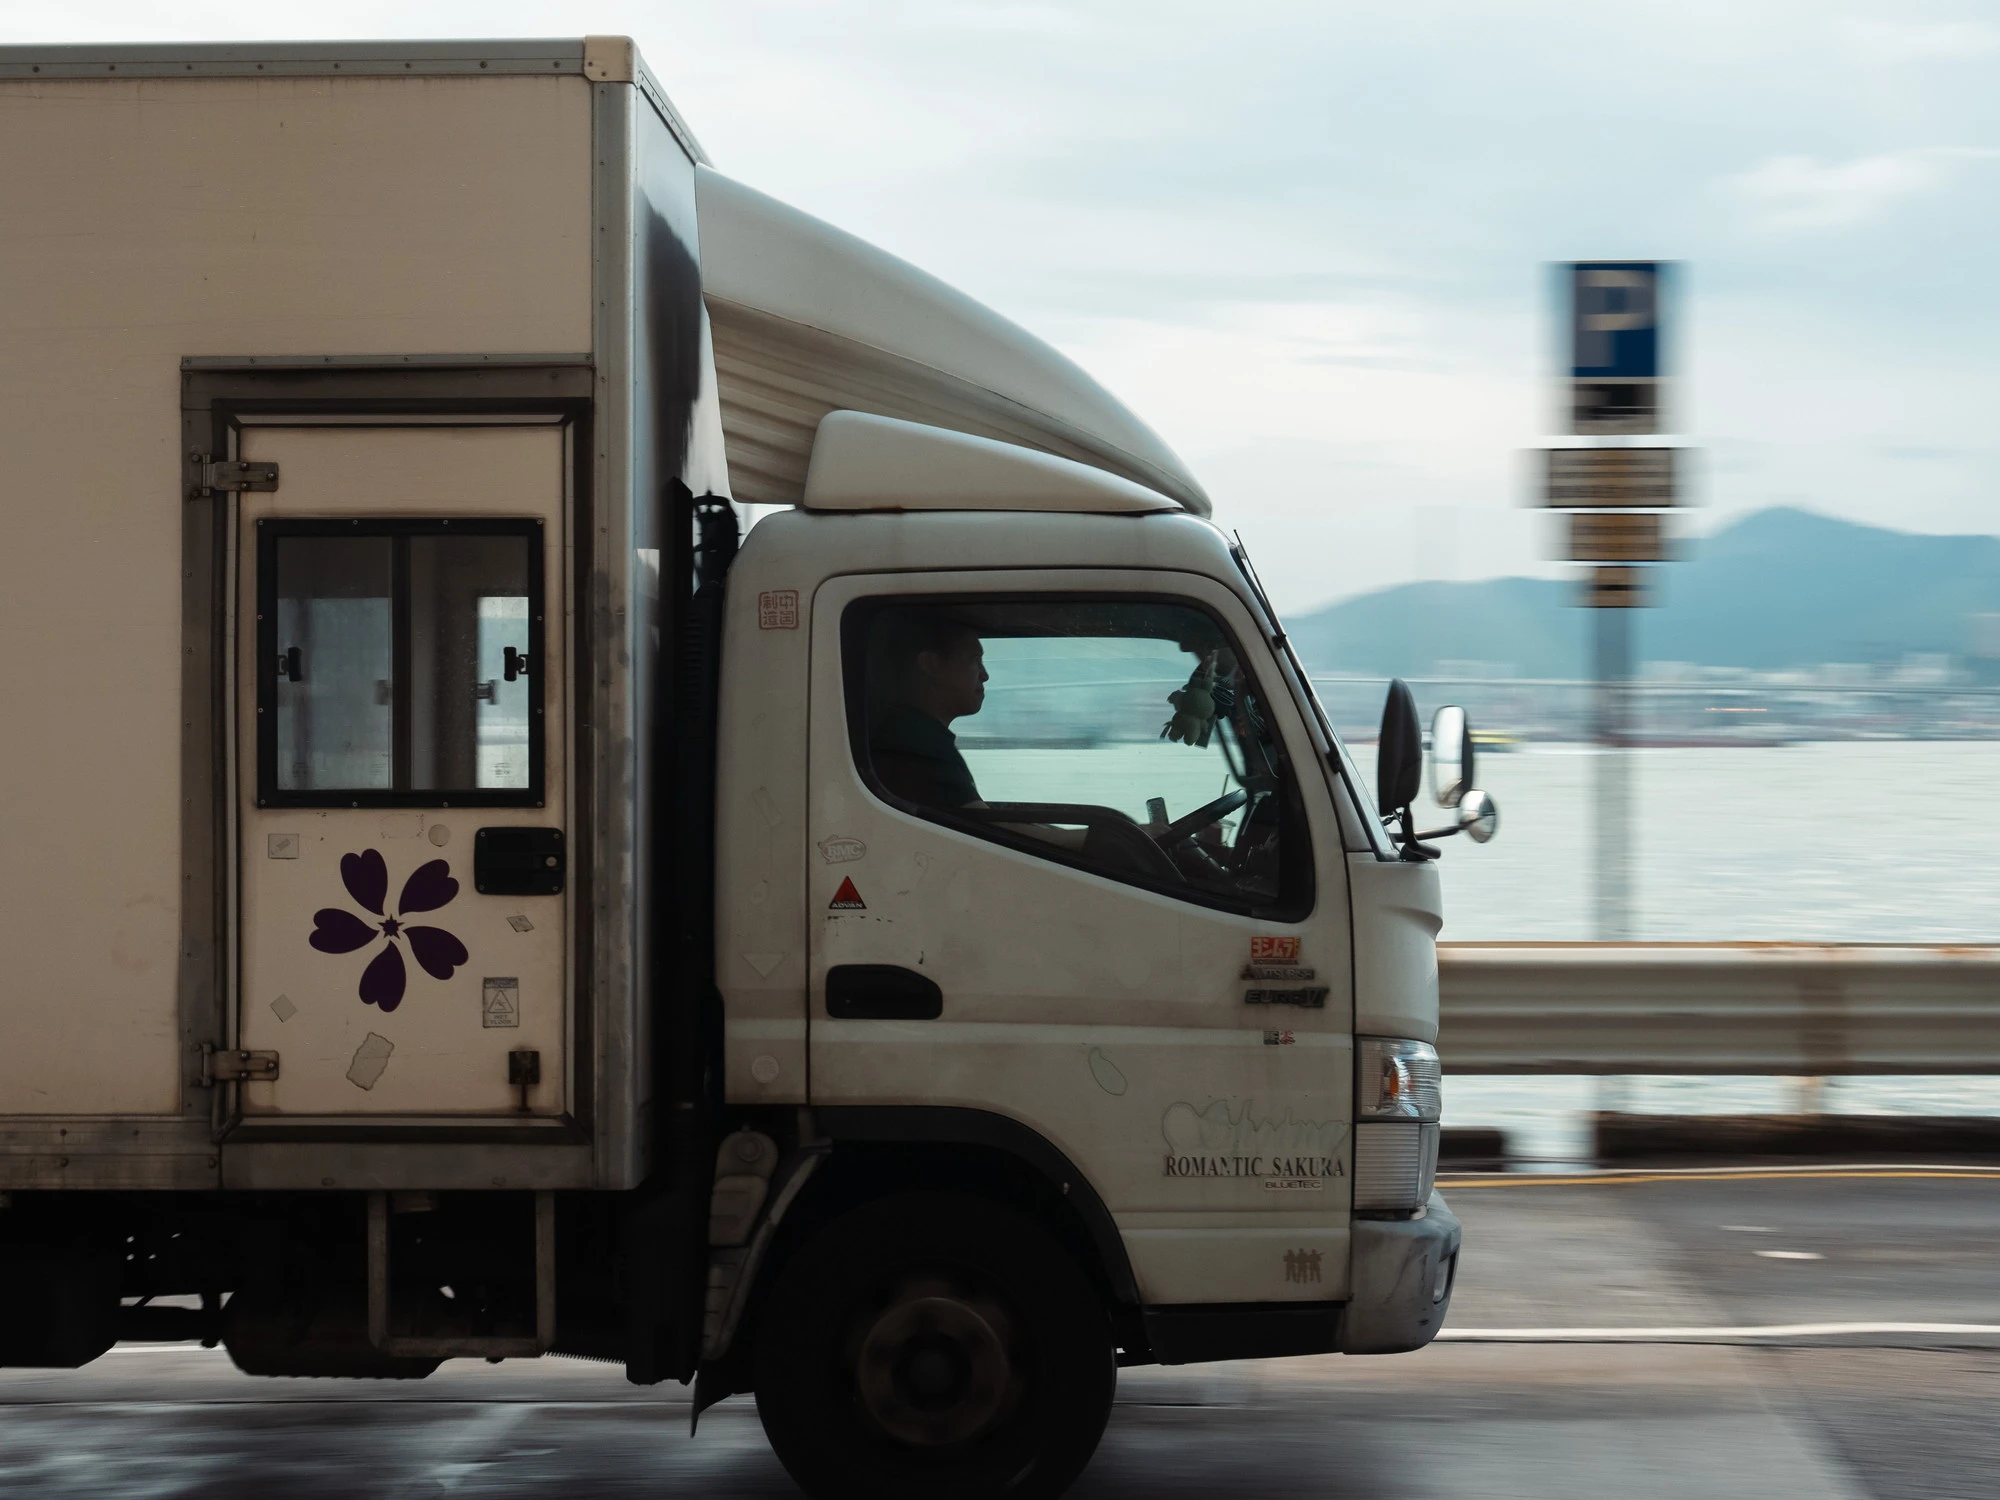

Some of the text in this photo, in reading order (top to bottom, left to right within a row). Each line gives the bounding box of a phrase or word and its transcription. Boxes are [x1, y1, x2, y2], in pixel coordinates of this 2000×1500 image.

[1252, 937, 1294, 958] ヨシムラ
[1165, 1156, 1345, 1176] ROMANTIC SAKURA
[1265, 1180, 1321, 1188] BLUETEC
